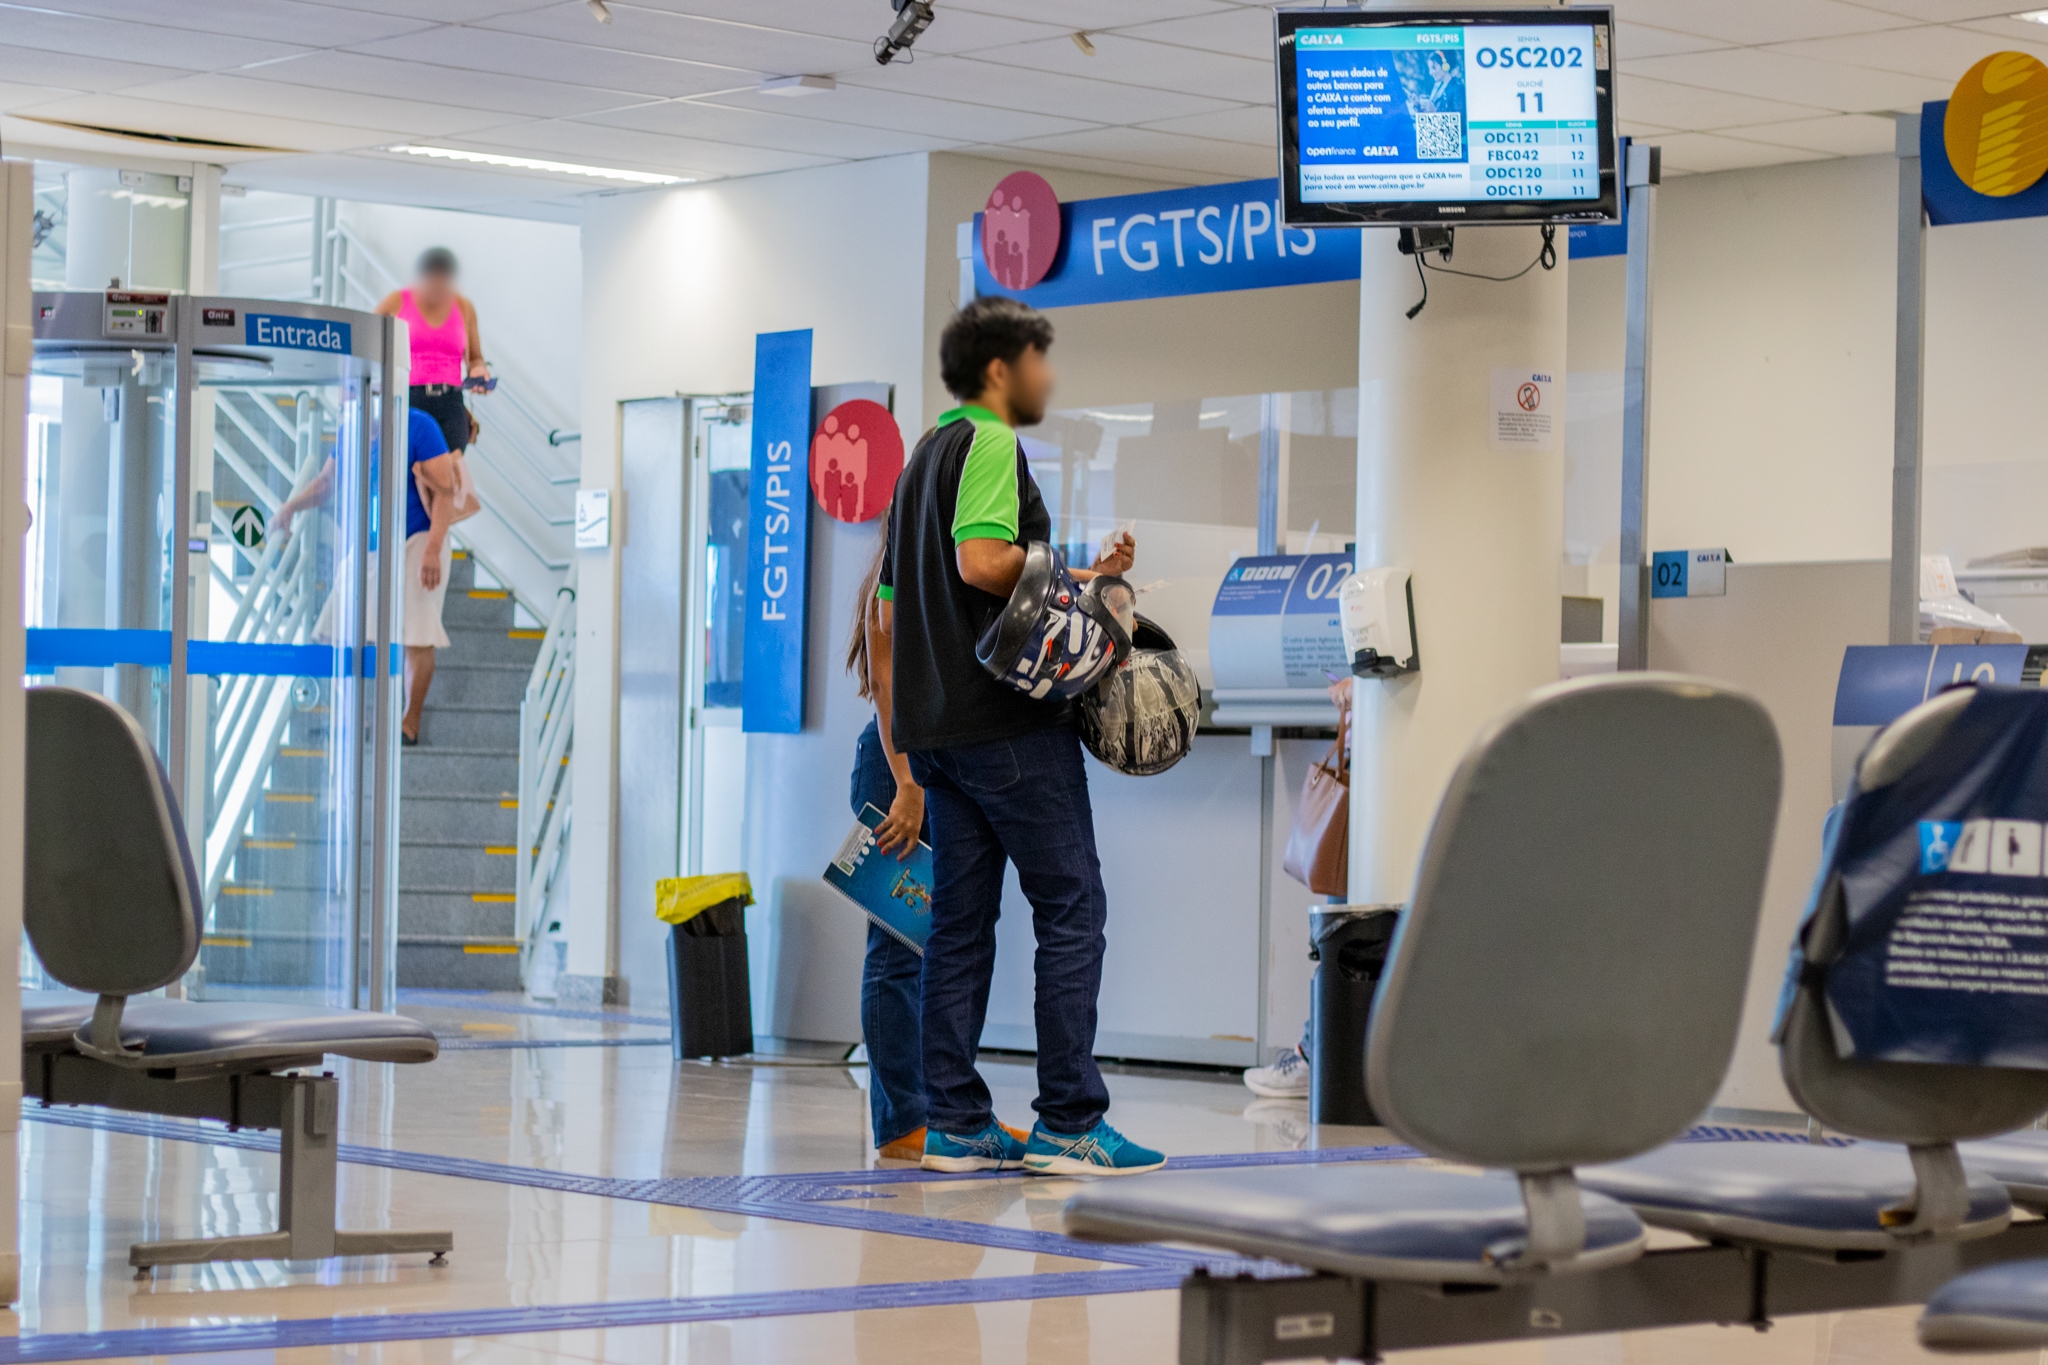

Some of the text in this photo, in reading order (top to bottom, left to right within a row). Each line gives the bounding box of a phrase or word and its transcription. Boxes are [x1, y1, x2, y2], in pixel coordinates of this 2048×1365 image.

[1300, 34, 1344, 45] CAIXA
[1416, 34, 1460, 44] FGTS/PIS
[1476, 47, 1582, 68] OSC202
[1306, 68, 1330, 80] Traga
[1350, 67, 1376, 77] dados
[1377, 68, 1388, 77] de
[1306, 80, 1384, 92] outros bancos para
[1315, 94, 1342, 102] CAIXA
[1350, 94, 1372, 102] conte
[1516, 92, 1544, 113] 11
[1307, 105, 1382, 117] ofertas adequadas
[1336, 116, 1360, 129] perfil.
[1484, 132, 1582, 143] ODC121 11
[1363, 146, 1399, 157] CAIXA
[1488, 150, 1584, 161] FBC042 12
[1304, 174, 1322, 182] Veja
[1357, 173, 1397, 182] vantagens
[1485, 168, 1584, 178] ODC120 11
[1358, 182, 1425, 191] www.caixa.gov.br
[1486, 185, 1584, 196] ODC119 11
[256, 317, 342, 350] Entrada
[762, 440, 792, 621] FGTS/PIS
[1697, 554, 1721, 563] CAIXA
[1658, 562, 1682, 586] 02
[1306, 562, 1353, 601] 02
